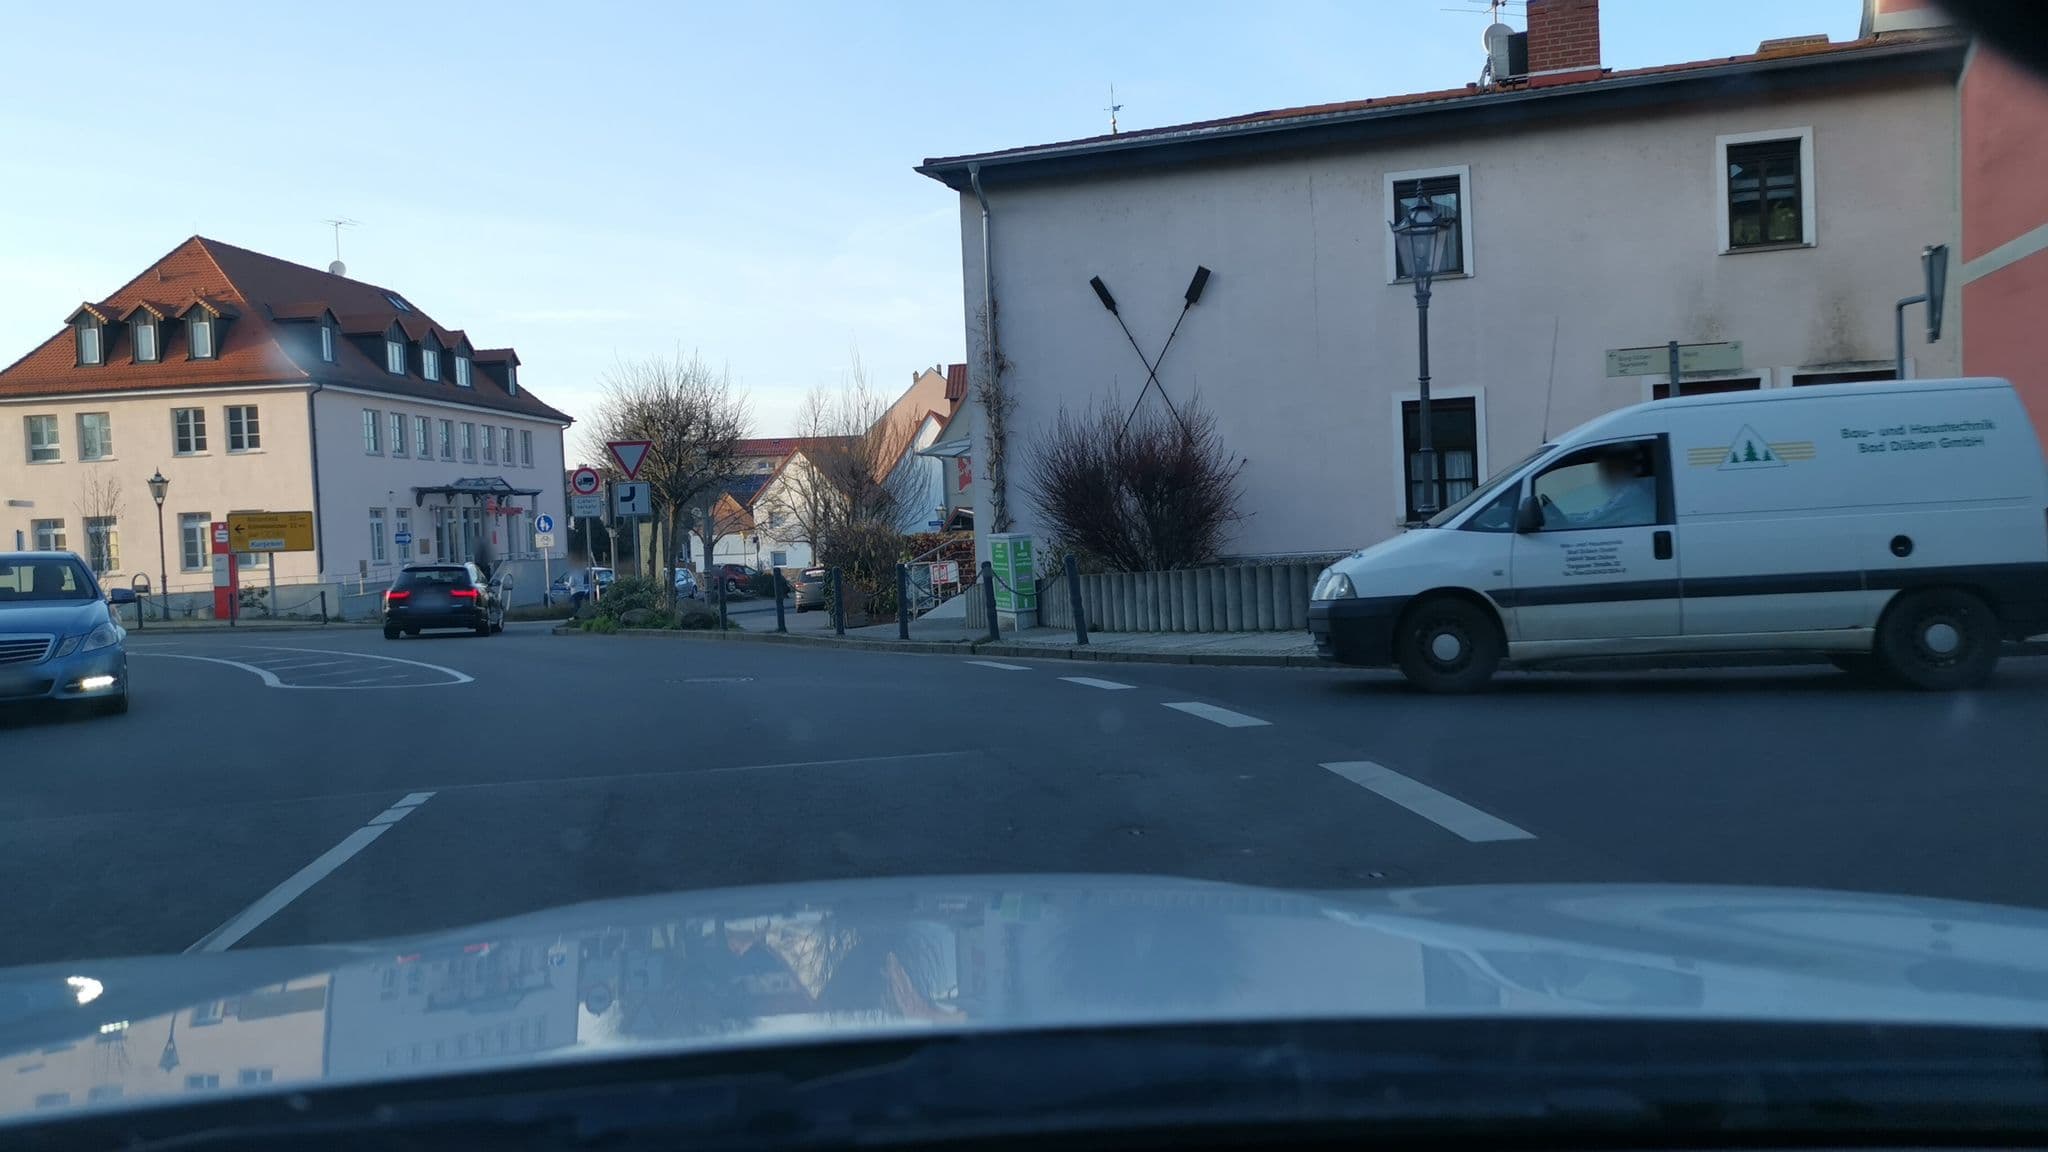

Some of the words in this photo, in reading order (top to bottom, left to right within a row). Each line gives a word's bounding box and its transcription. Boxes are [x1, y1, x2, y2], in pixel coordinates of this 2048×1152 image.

[1840, 428, 1875, 439] Bau-
[1878, 424, 1906, 436] und
[1910, 419, 1995, 434] Haustechnik
[1857, 442, 1885, 453] Bad
[1889, 439, 1936, 451] Düben
[1939, 437, 1985, 448] GmbH
